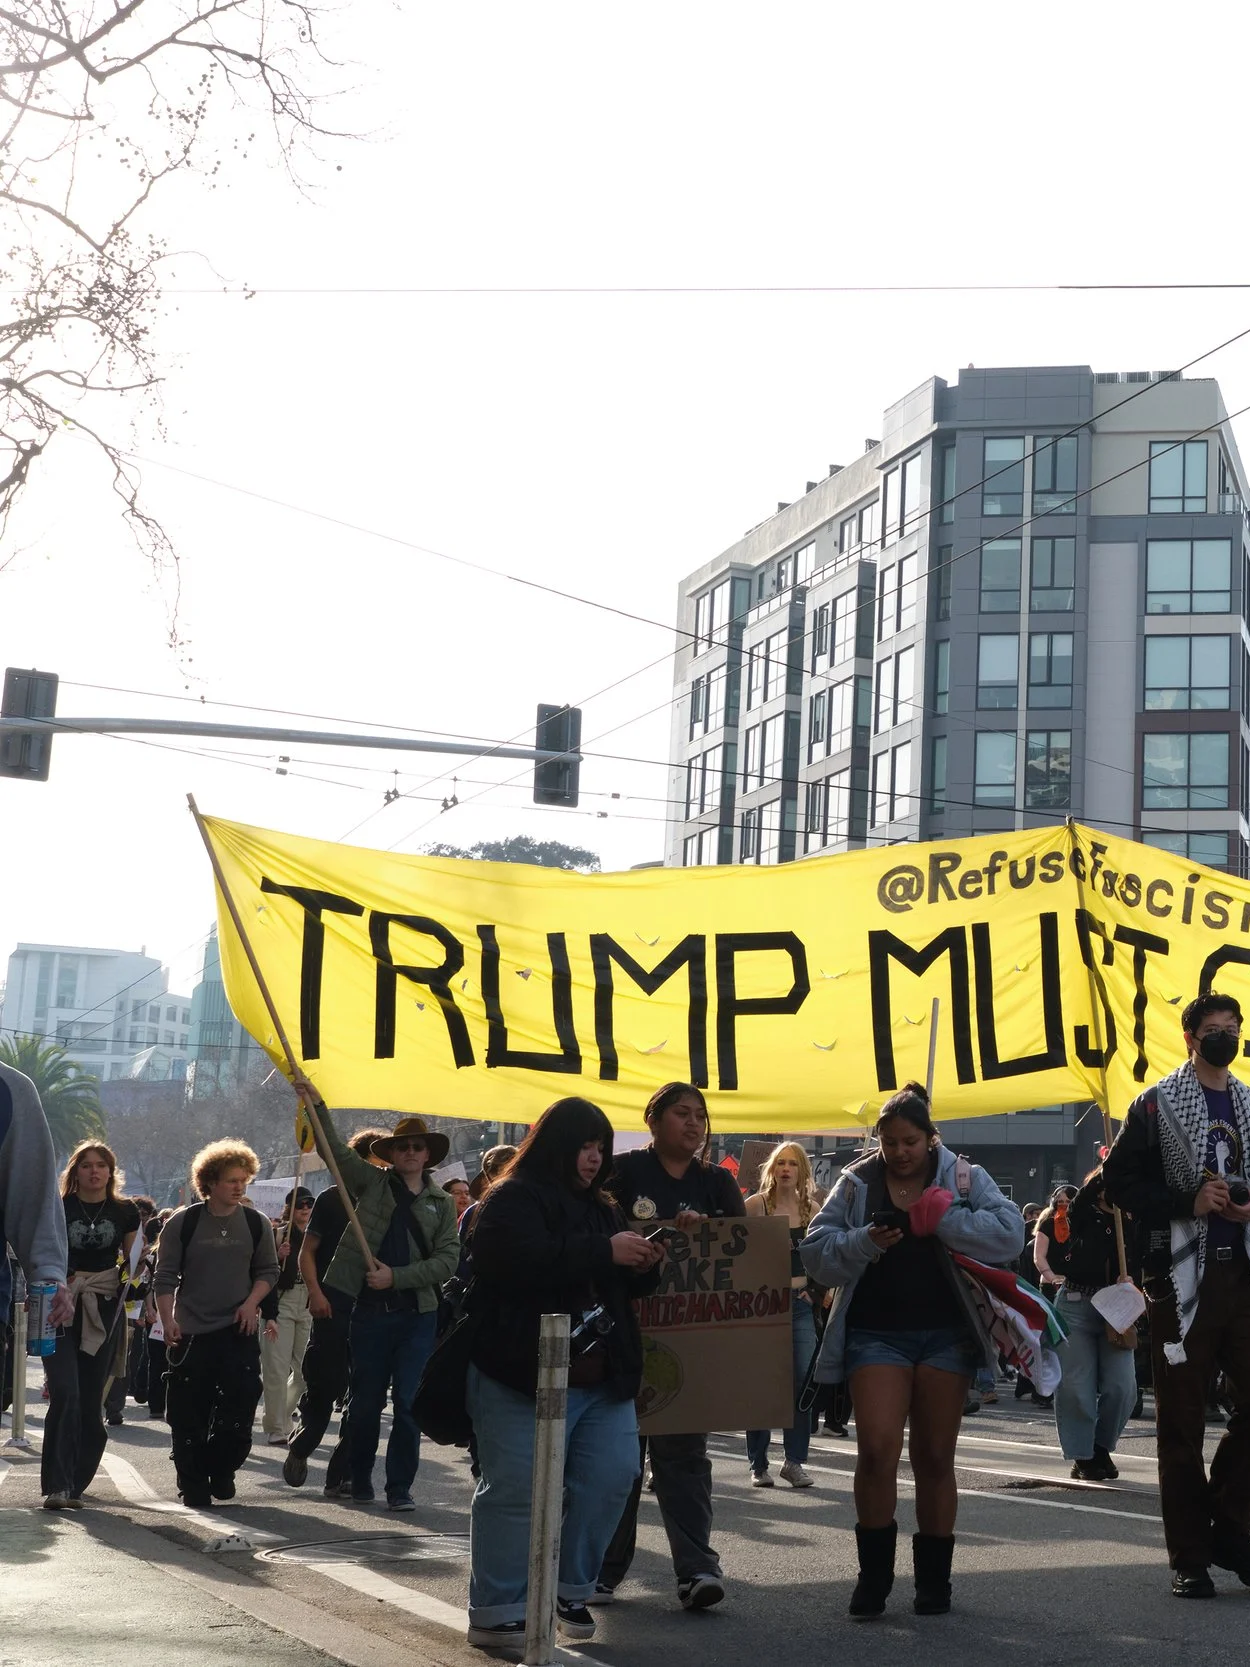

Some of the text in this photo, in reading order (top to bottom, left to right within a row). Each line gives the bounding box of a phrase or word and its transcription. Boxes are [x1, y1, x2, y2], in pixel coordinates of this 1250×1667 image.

[261, 877, 811, 1090] TRUMP
[868, 909, 1169, 1092] MUST
[657, 1257, 734, 1294] AKE
